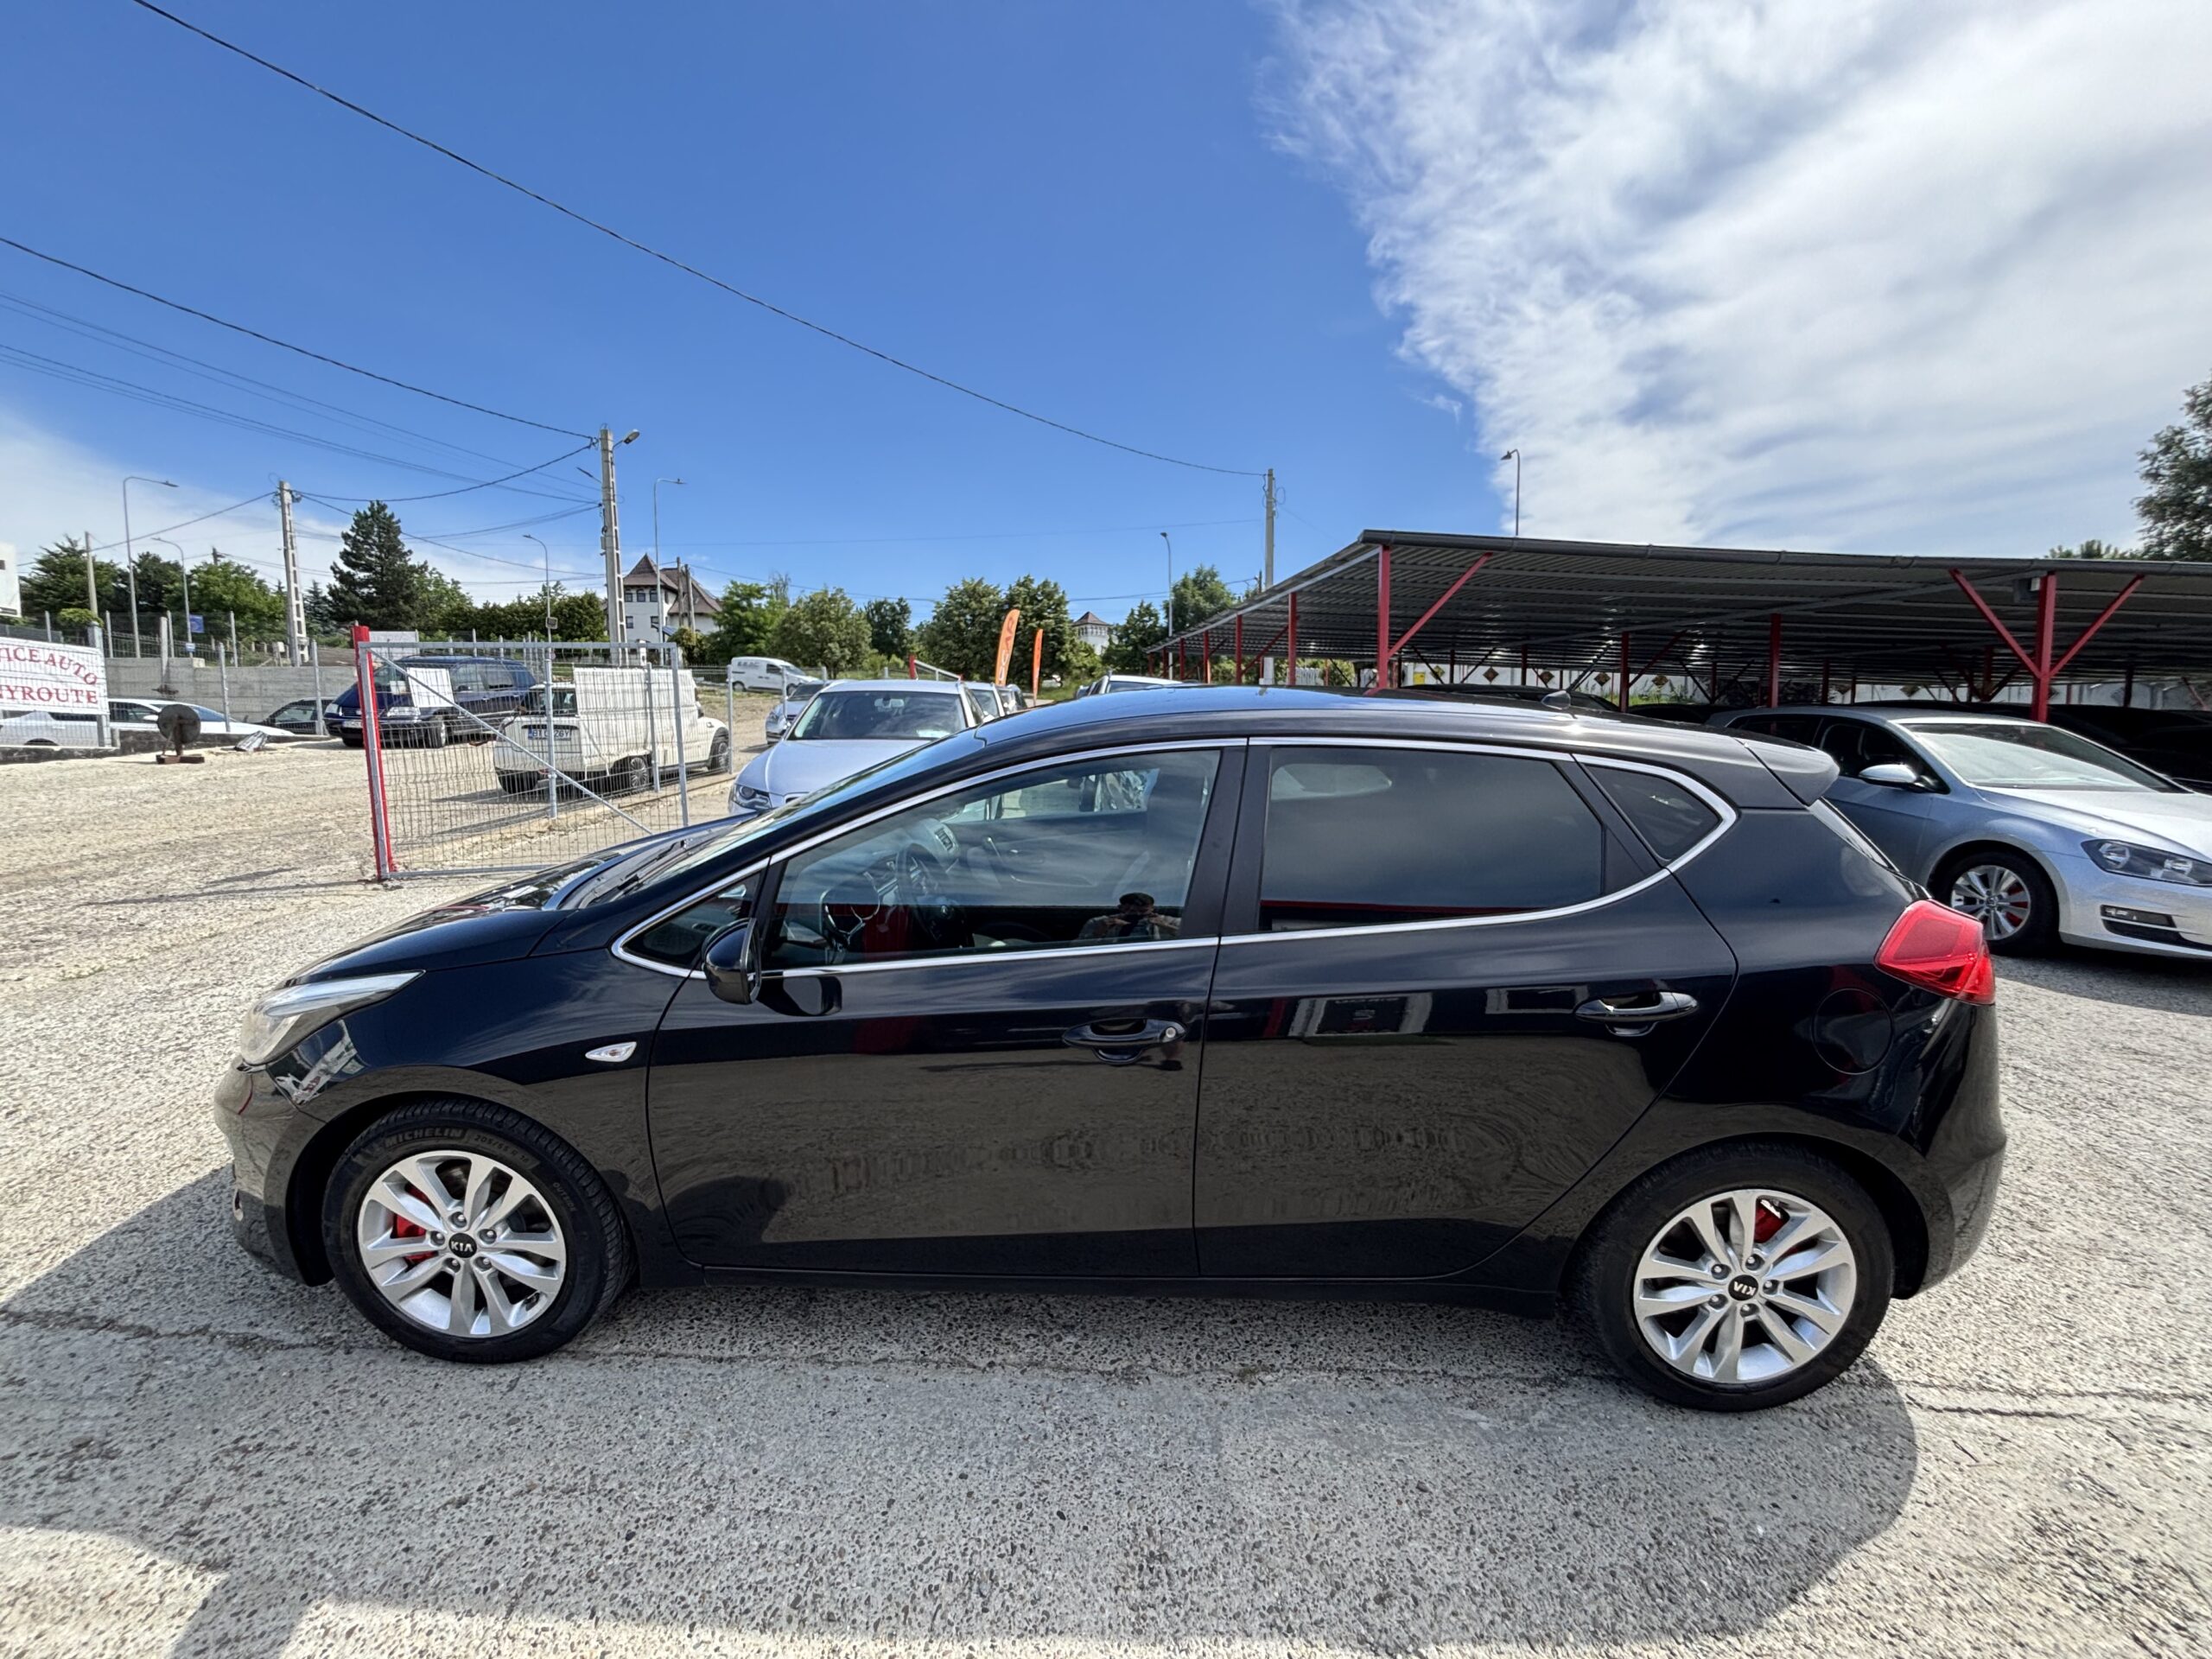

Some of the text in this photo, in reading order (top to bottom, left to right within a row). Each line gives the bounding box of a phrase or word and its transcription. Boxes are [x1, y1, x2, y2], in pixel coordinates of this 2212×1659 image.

[44, 652, 98, 685] AUTO
[385, 1128, 463, 1148] MICHELIN
[451, 1241, 474, 1252] KIA
[1733, 1281, 1757, 1296] KIA
